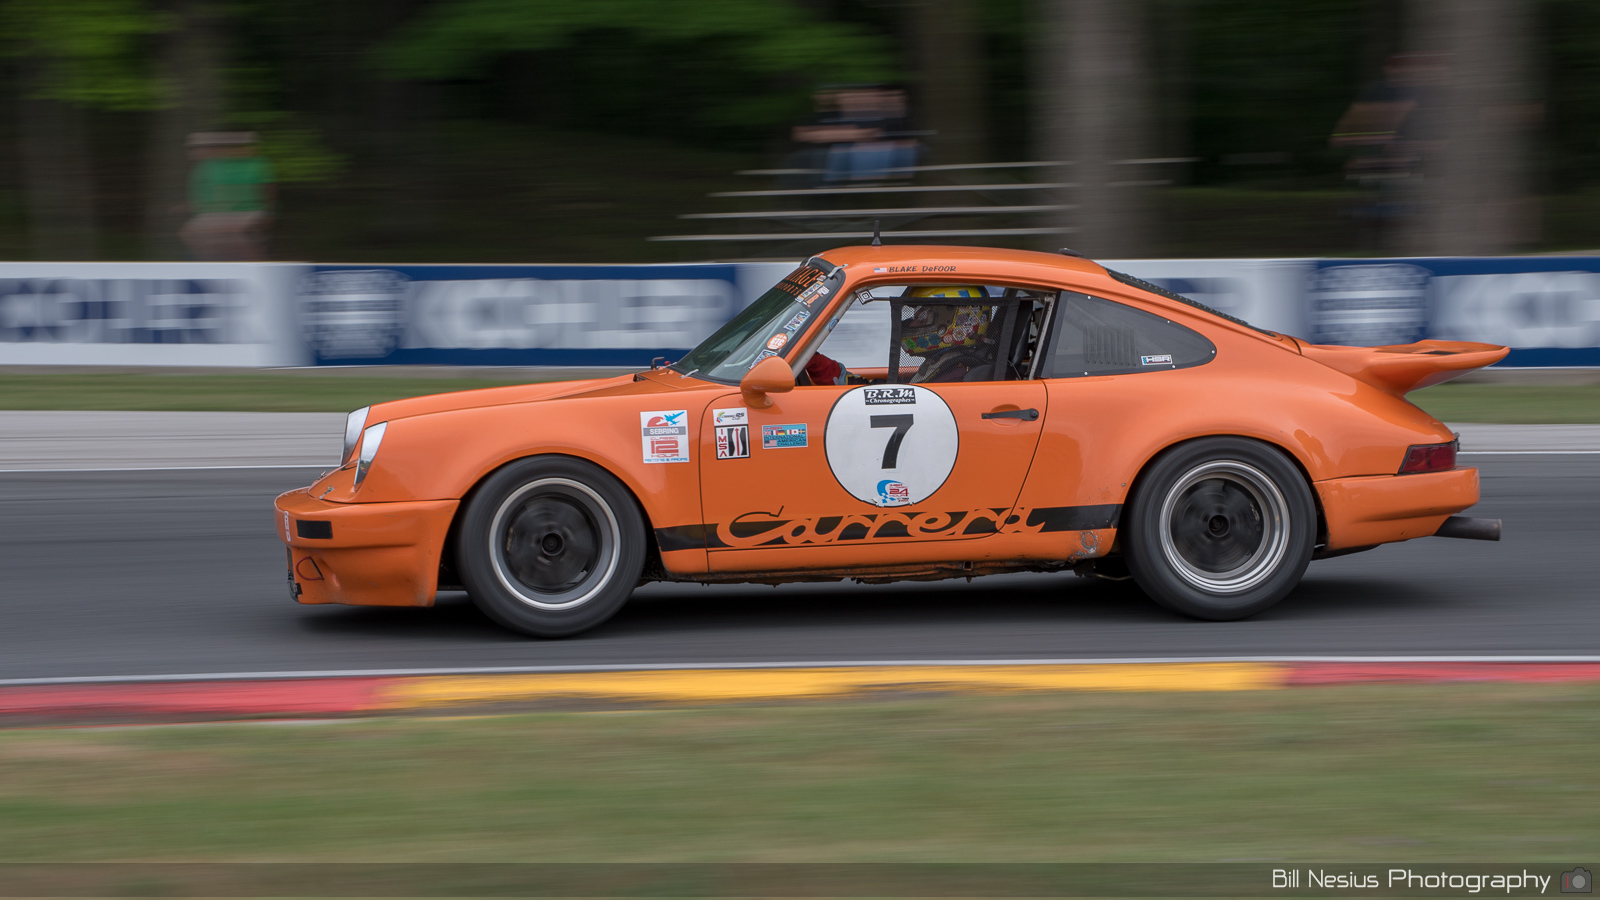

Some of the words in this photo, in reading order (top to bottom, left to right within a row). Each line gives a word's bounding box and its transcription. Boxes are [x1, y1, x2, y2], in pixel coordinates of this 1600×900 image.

[922, 265, 957, 273] DeFOOR
[865, 389, 914, 399] B.R.M
[649, 427, 679, 435] SEBRING
[650, 440, 679, 454] 12
[718, 429, 728, 457] IMSA
[870, 414, 914, 470] 7
[889, 488, 909, 496] 24
[716, 505, 1045, 548] Carrera
